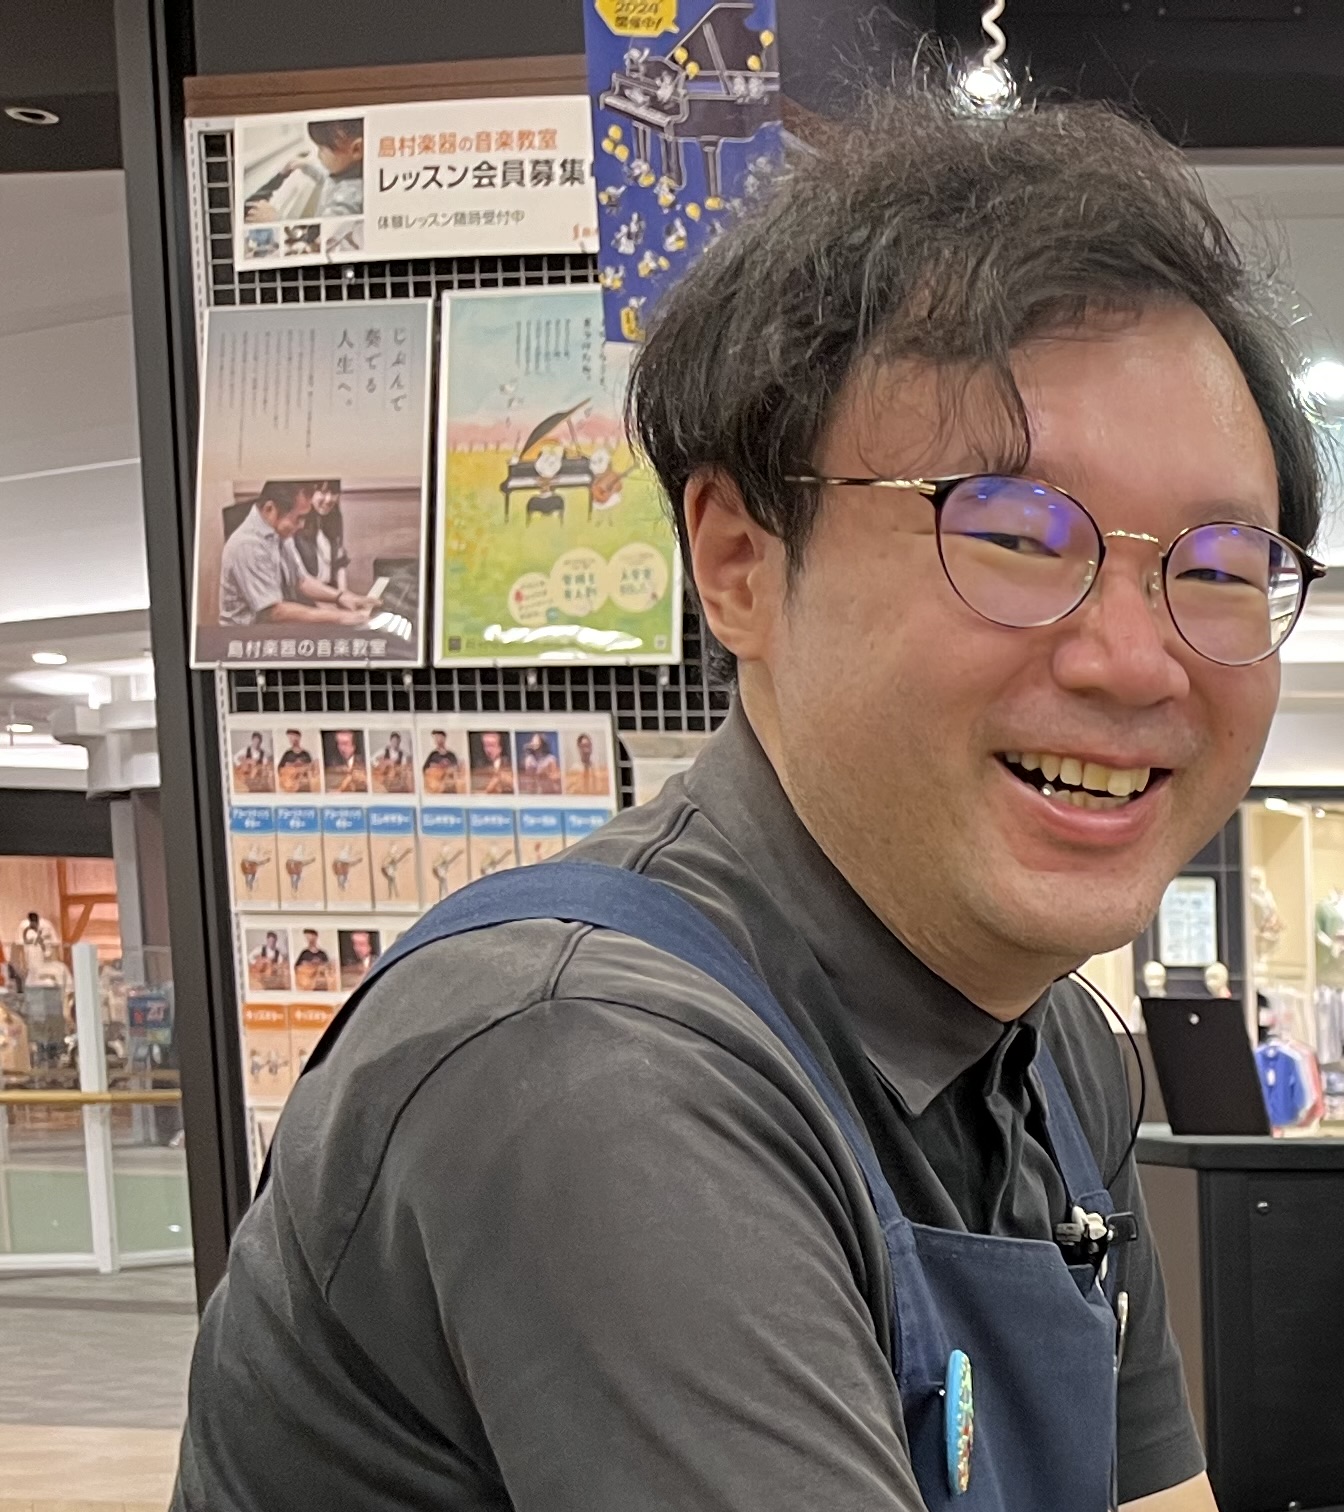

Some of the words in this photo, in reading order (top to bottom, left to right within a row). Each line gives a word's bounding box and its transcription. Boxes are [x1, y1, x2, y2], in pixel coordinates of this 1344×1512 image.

[378, 128, 558, 157] 島村楽器の音楽教室
[379, 158, 586, 192] レッスン会員募集
[335, 328, 354, 407] 人生へ。
[227, 638, 387, 659] 島村楽器の音楽教室
